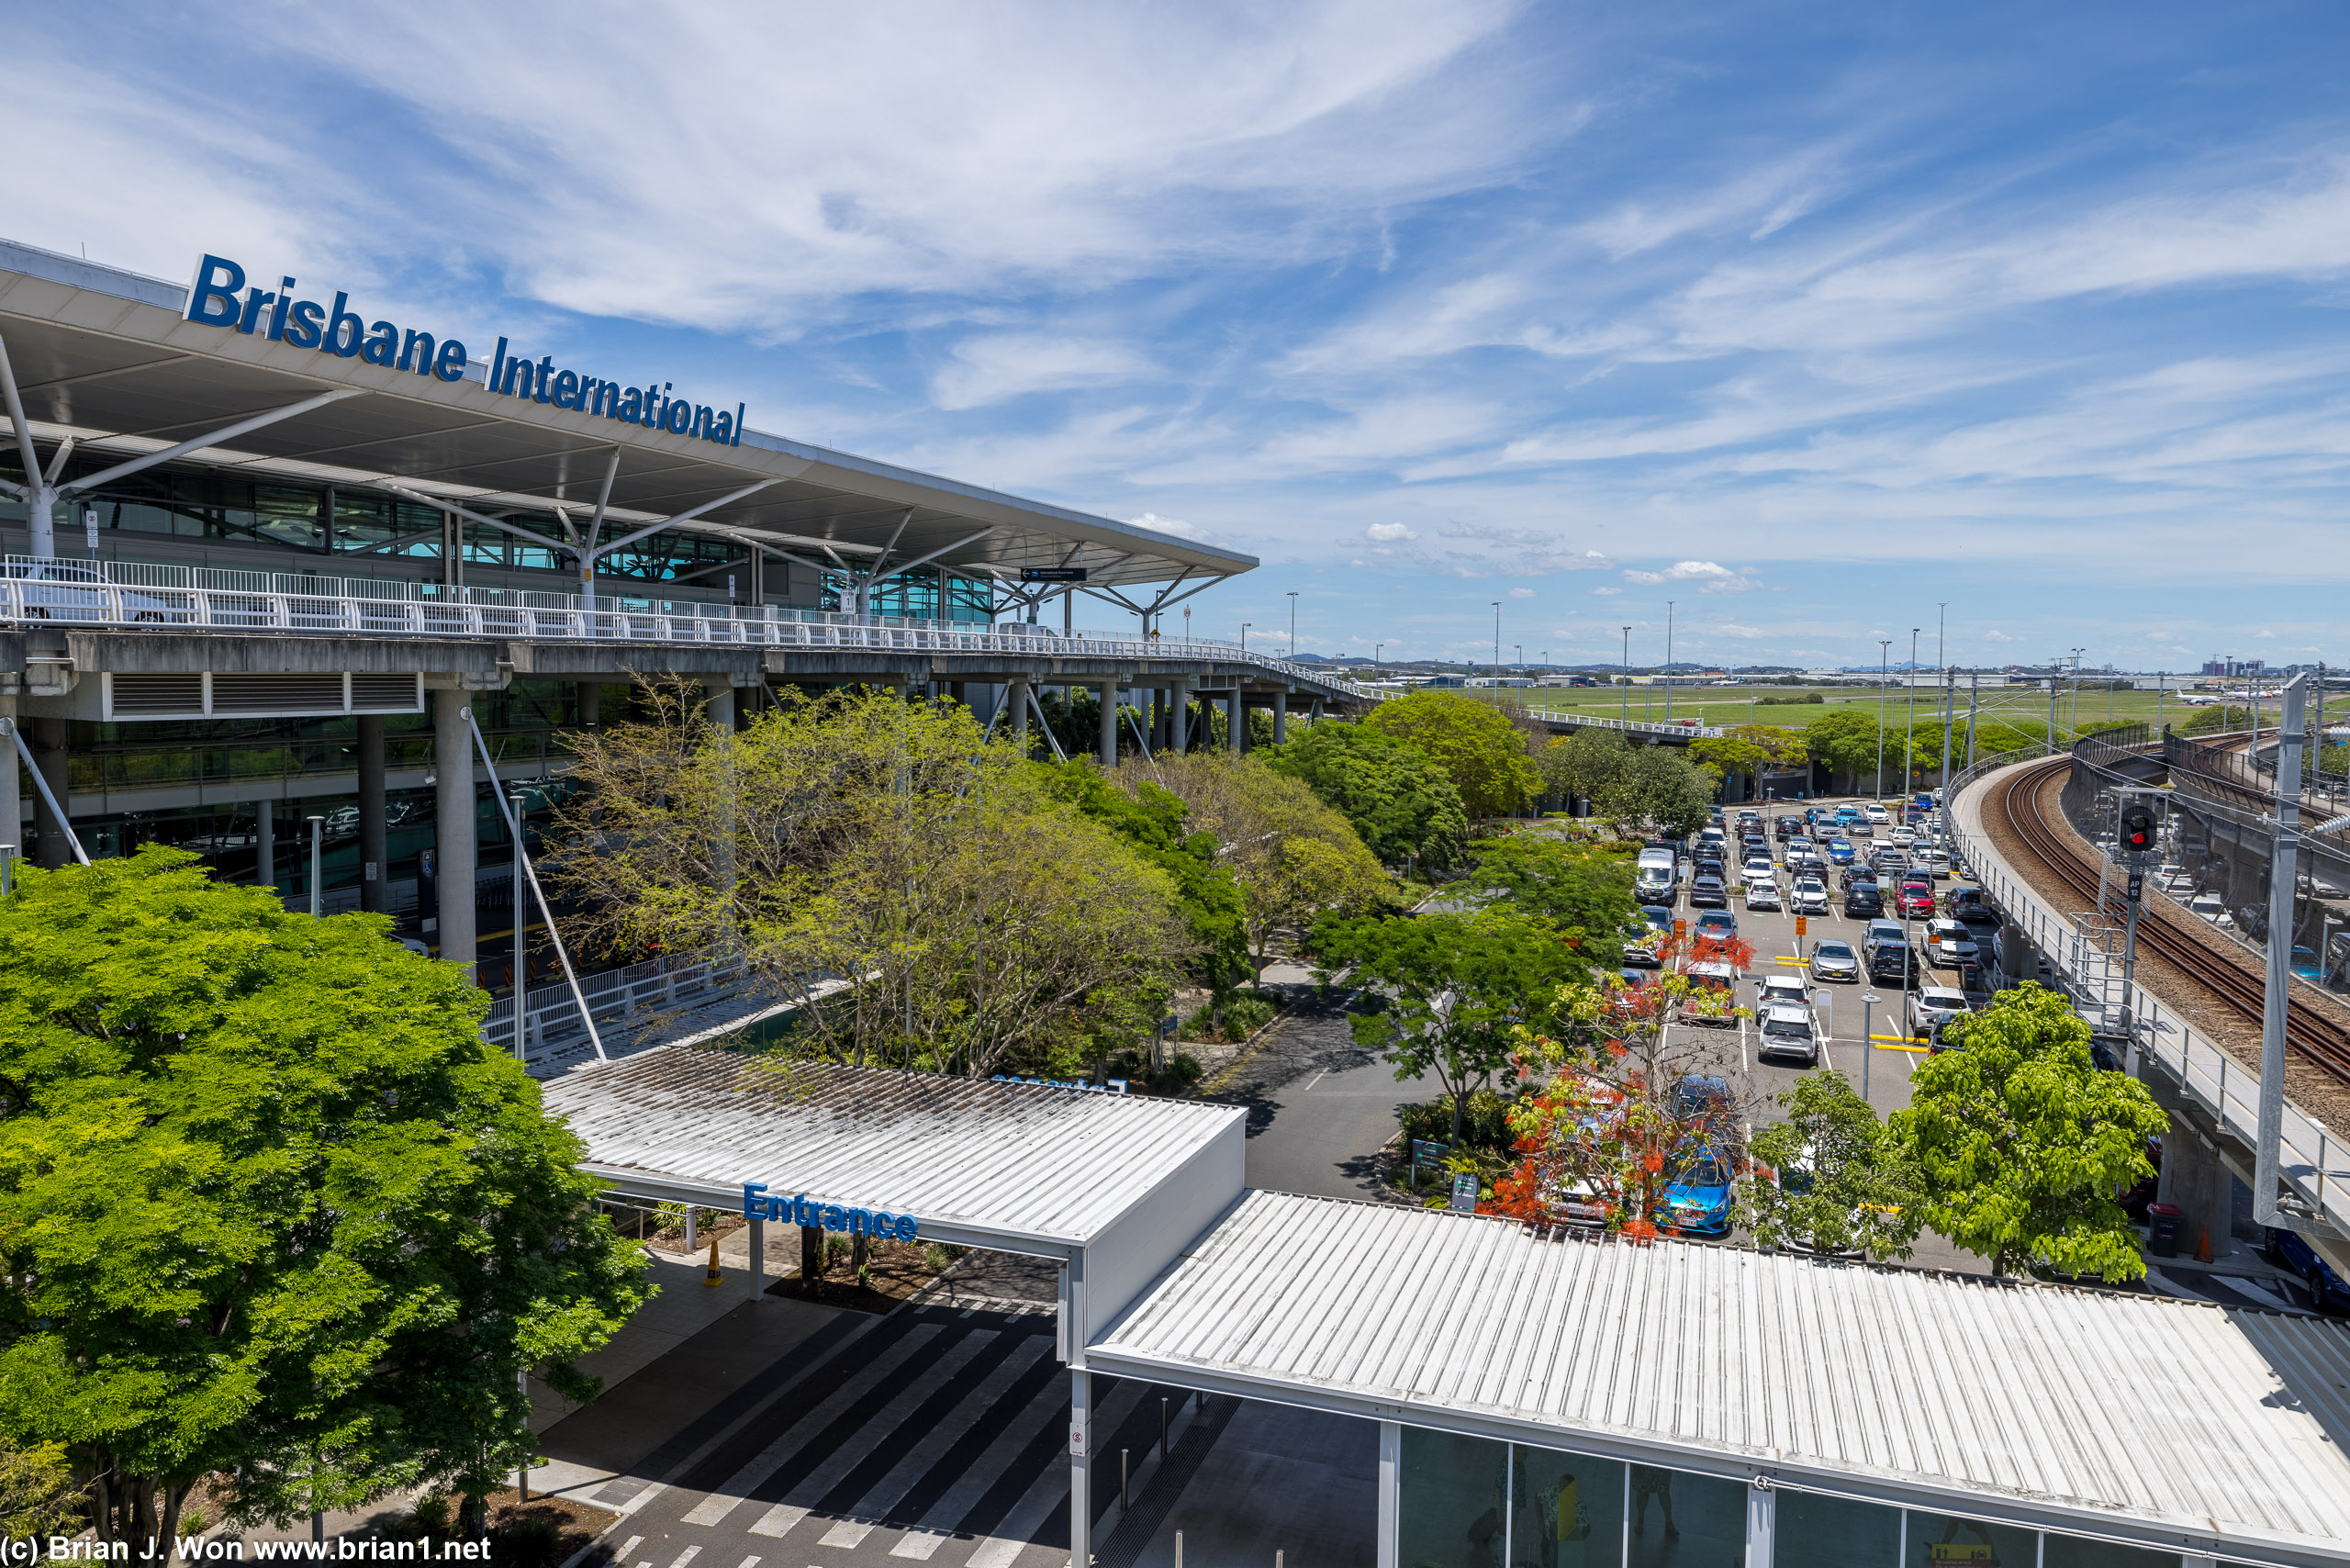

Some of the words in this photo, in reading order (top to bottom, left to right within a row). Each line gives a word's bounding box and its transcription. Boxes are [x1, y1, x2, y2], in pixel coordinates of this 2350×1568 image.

[184, 253, 467, 382] Brisbane
[486, 336, 745, 447] International
[846, 598, 850, 606] 1
[744, 1183, 919, 1242] Entrance
